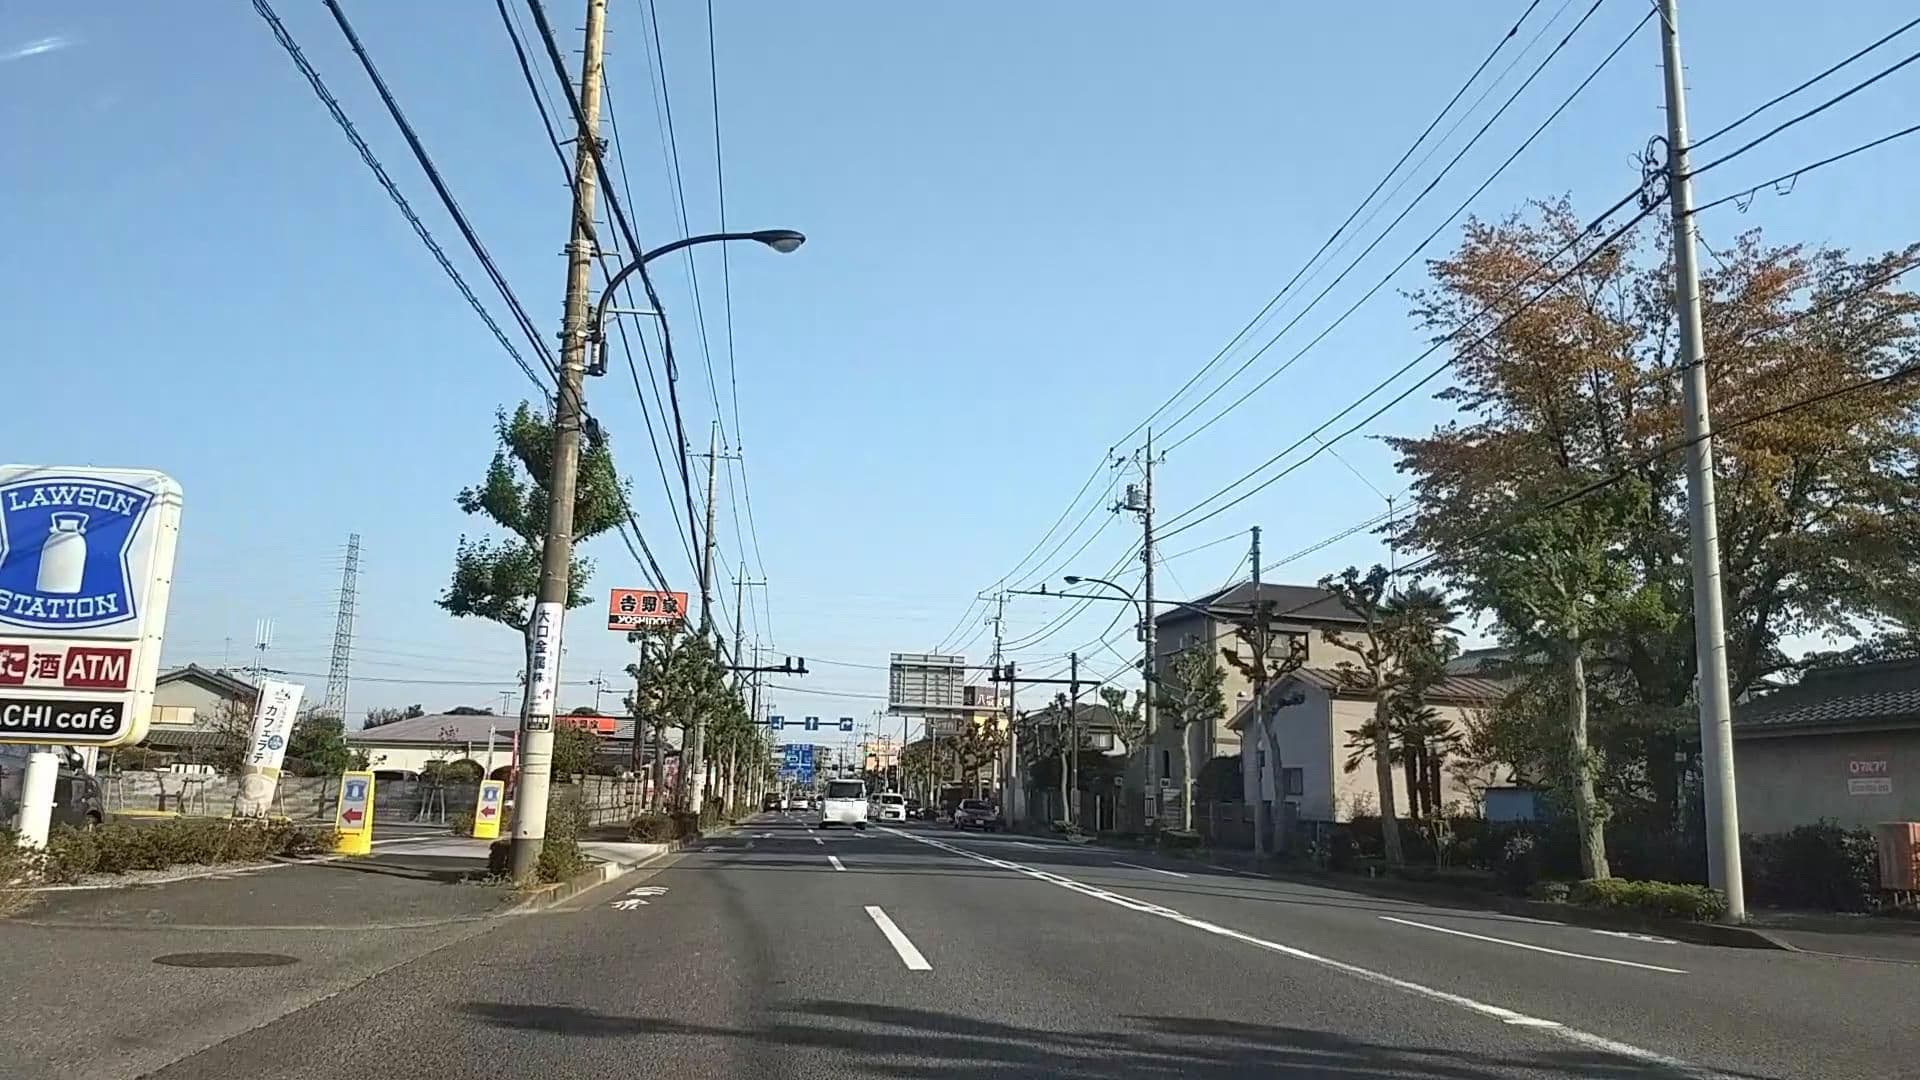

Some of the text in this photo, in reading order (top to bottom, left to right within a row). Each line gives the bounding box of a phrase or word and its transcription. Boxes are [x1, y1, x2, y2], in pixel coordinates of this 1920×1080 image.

[8, 486, 138, 516] LAWSON
[0, 590, 118, 619] STATION
[30, 652, 62, 679] 酒
[66, 655, 125, 681] ATM
[0, 704, 116, 730] CHI café
[253, 705, 278, 765] カフェラテ
